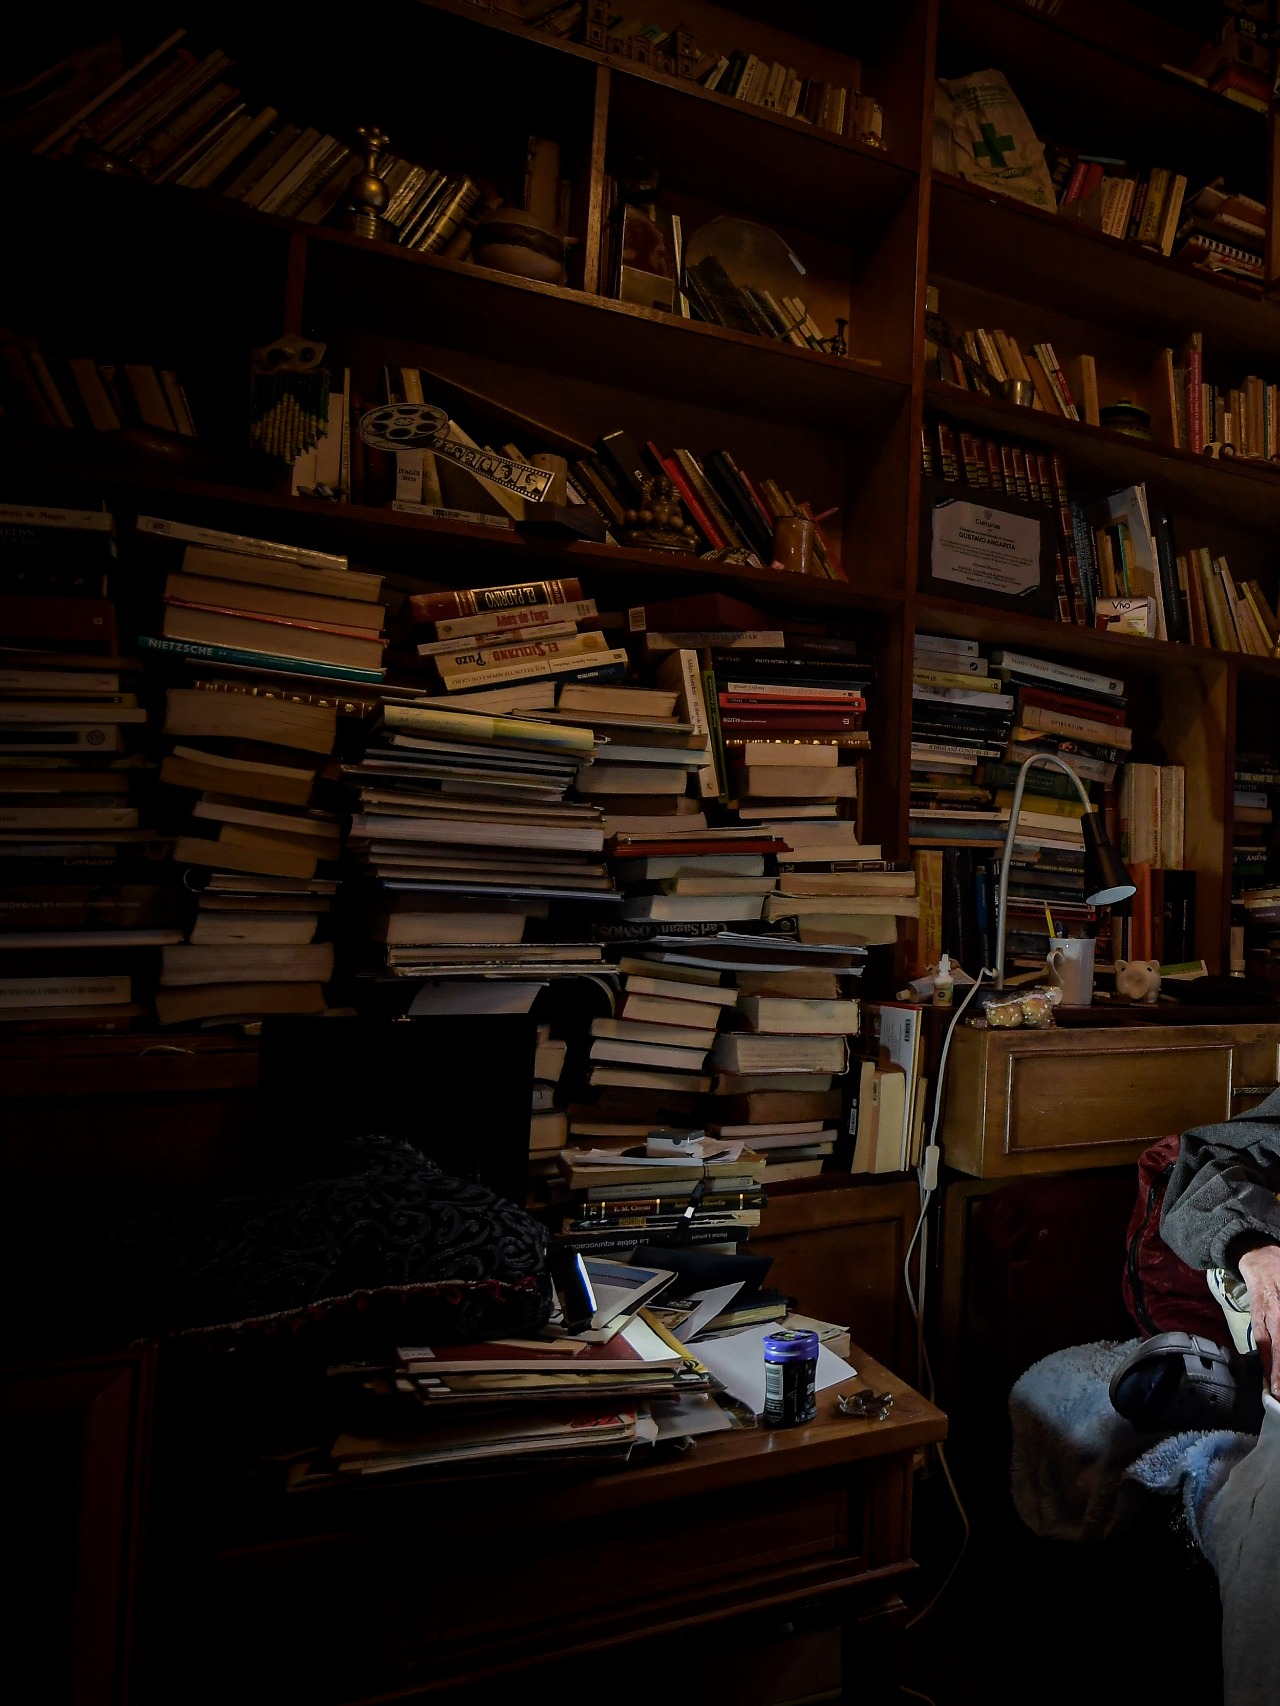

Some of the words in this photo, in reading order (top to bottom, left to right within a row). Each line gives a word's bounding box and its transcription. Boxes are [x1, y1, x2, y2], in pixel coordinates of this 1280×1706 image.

[959, 532, 986, 543] GUSTAVO
[485, 588, 524, 608] PADRINO
[522, 586, 536, 604] EL
[518, 612, 529, 623] de
[148, 638, 214, 656] NIETZSCHE
[1246, 854, 1267, 862] SONY
[599, 924, 659, 941] COSMOS
[661, 922, 699, 935] Sagan
[700, 922, 727, 933] Carl
